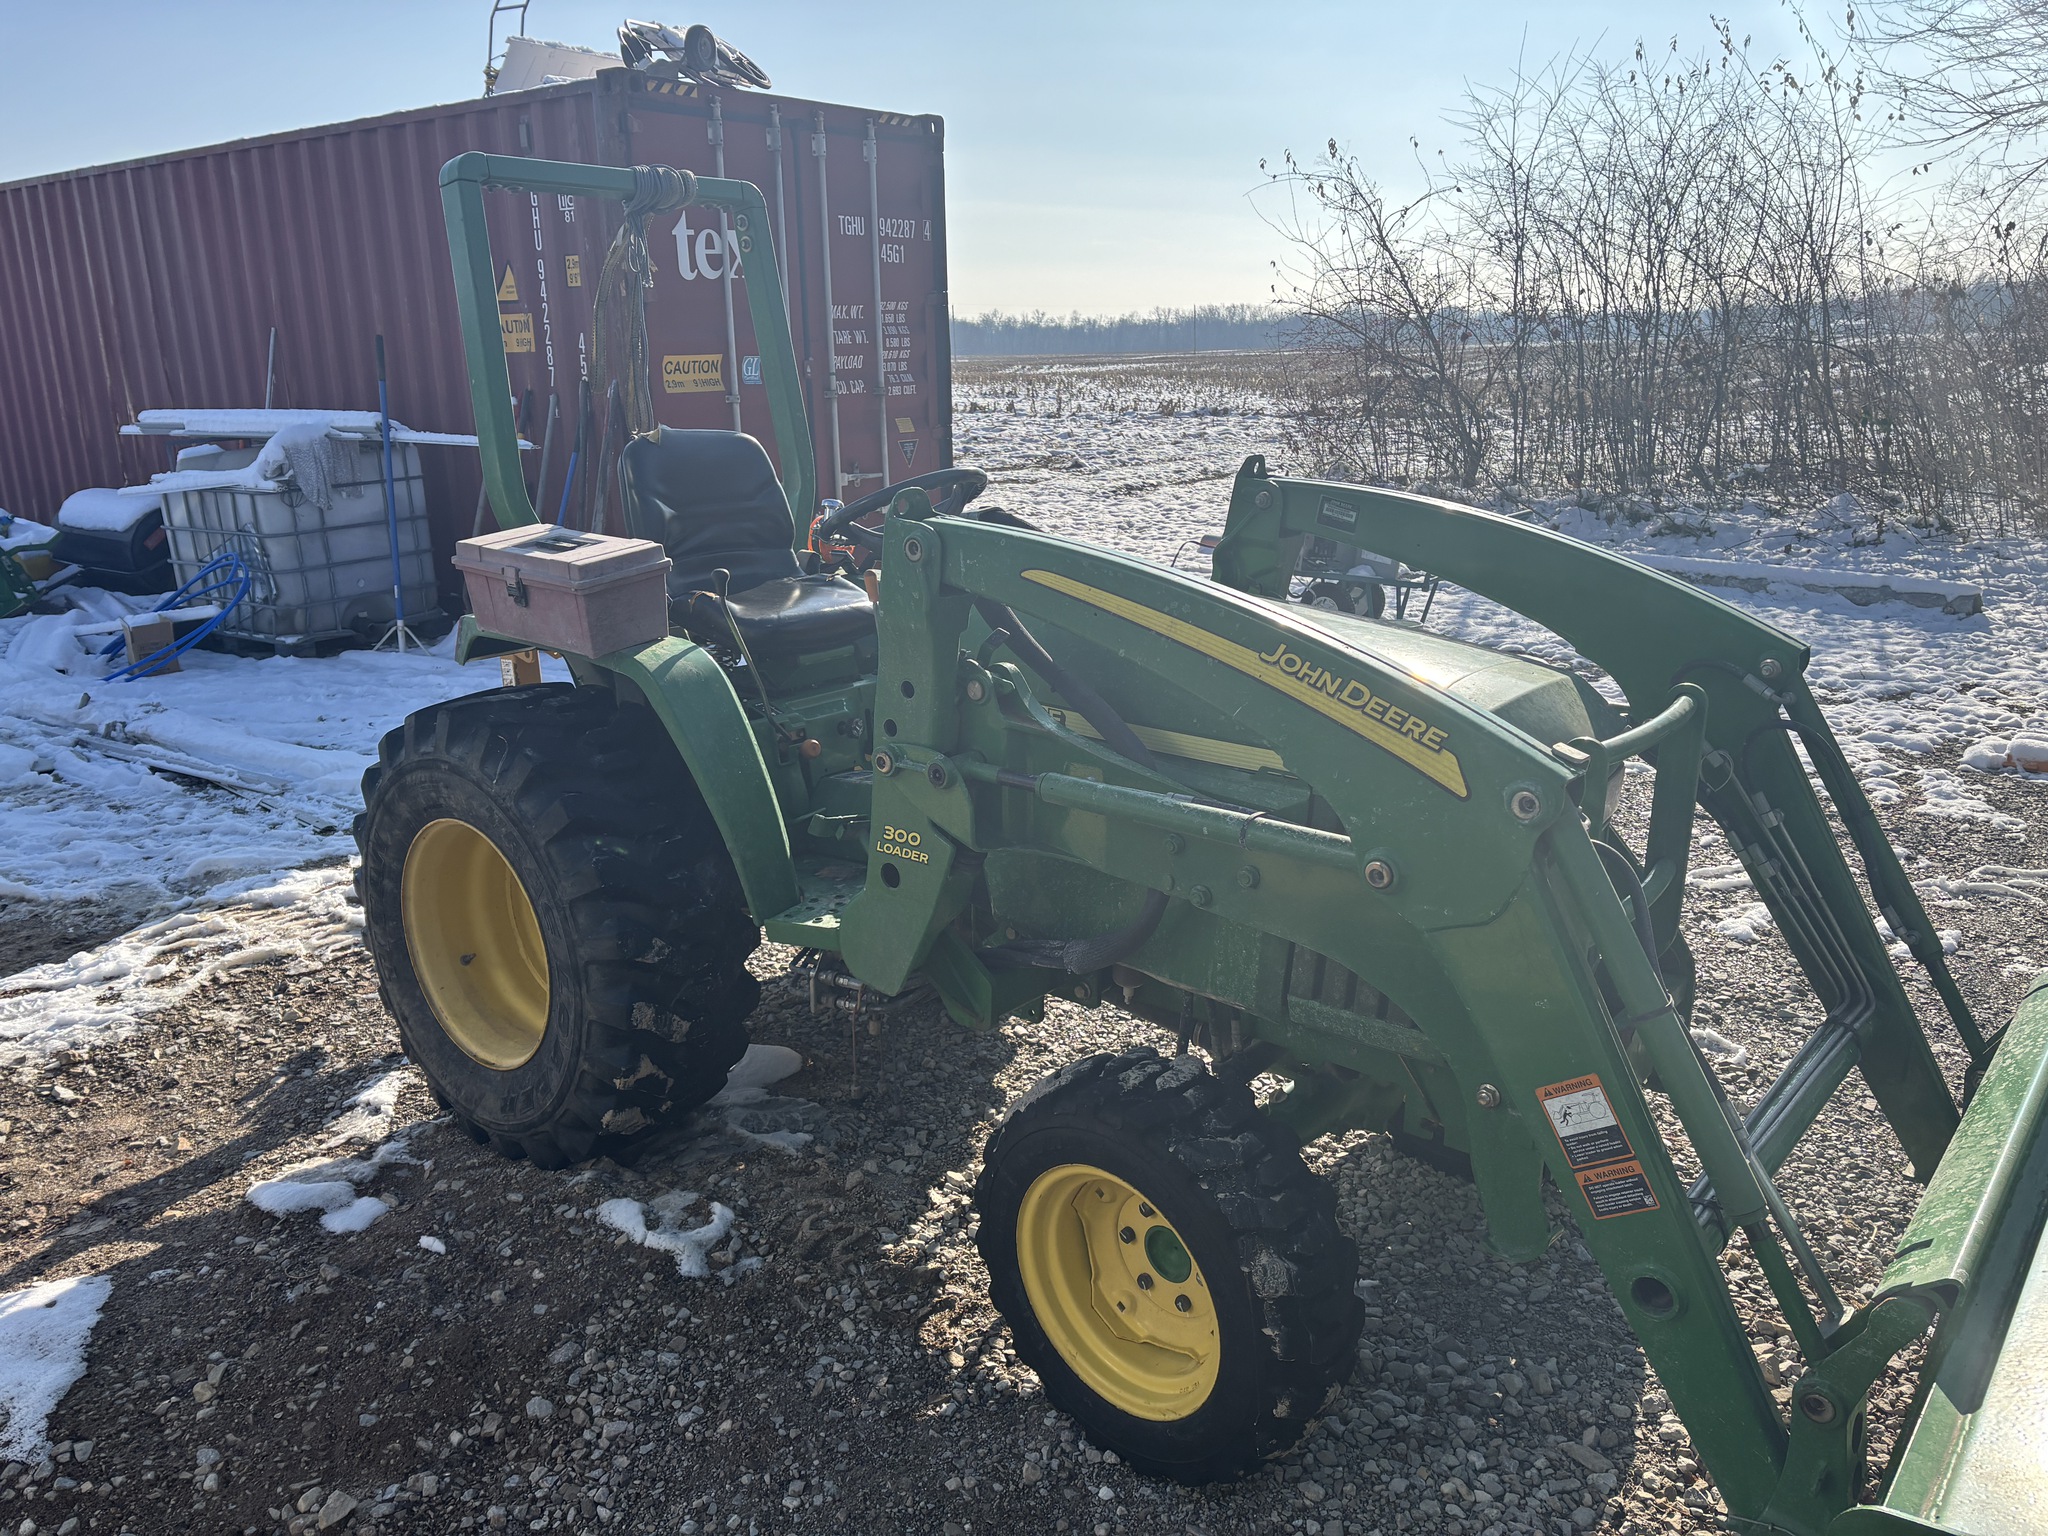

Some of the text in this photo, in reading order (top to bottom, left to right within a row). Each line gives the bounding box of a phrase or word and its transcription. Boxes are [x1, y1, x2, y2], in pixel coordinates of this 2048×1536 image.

[838, 215, 865, 236] TGHU
[879, 217, 916, 239] 942287
[880, 243, 905, 264] 45G1
[530, 191, 555, 387] GHU 942287
[851, 304, 864, 319] WT.
[833, 330, 869, 345] TARE WT.
[664, 360, 719, 375] CAUTION
[834, 354, 864, 369] PAYLOAD
[850, 379, 867, 394] CAP.
[1259, 643, 1449, 752] JOHN DEERE
[883, 824, 921, 846] 300
[876, 840, 929, 864] LOADER
[1552, 1078, 1593, 1095] WARNING
[1593, 1165, 1635, 1180] WARNING
